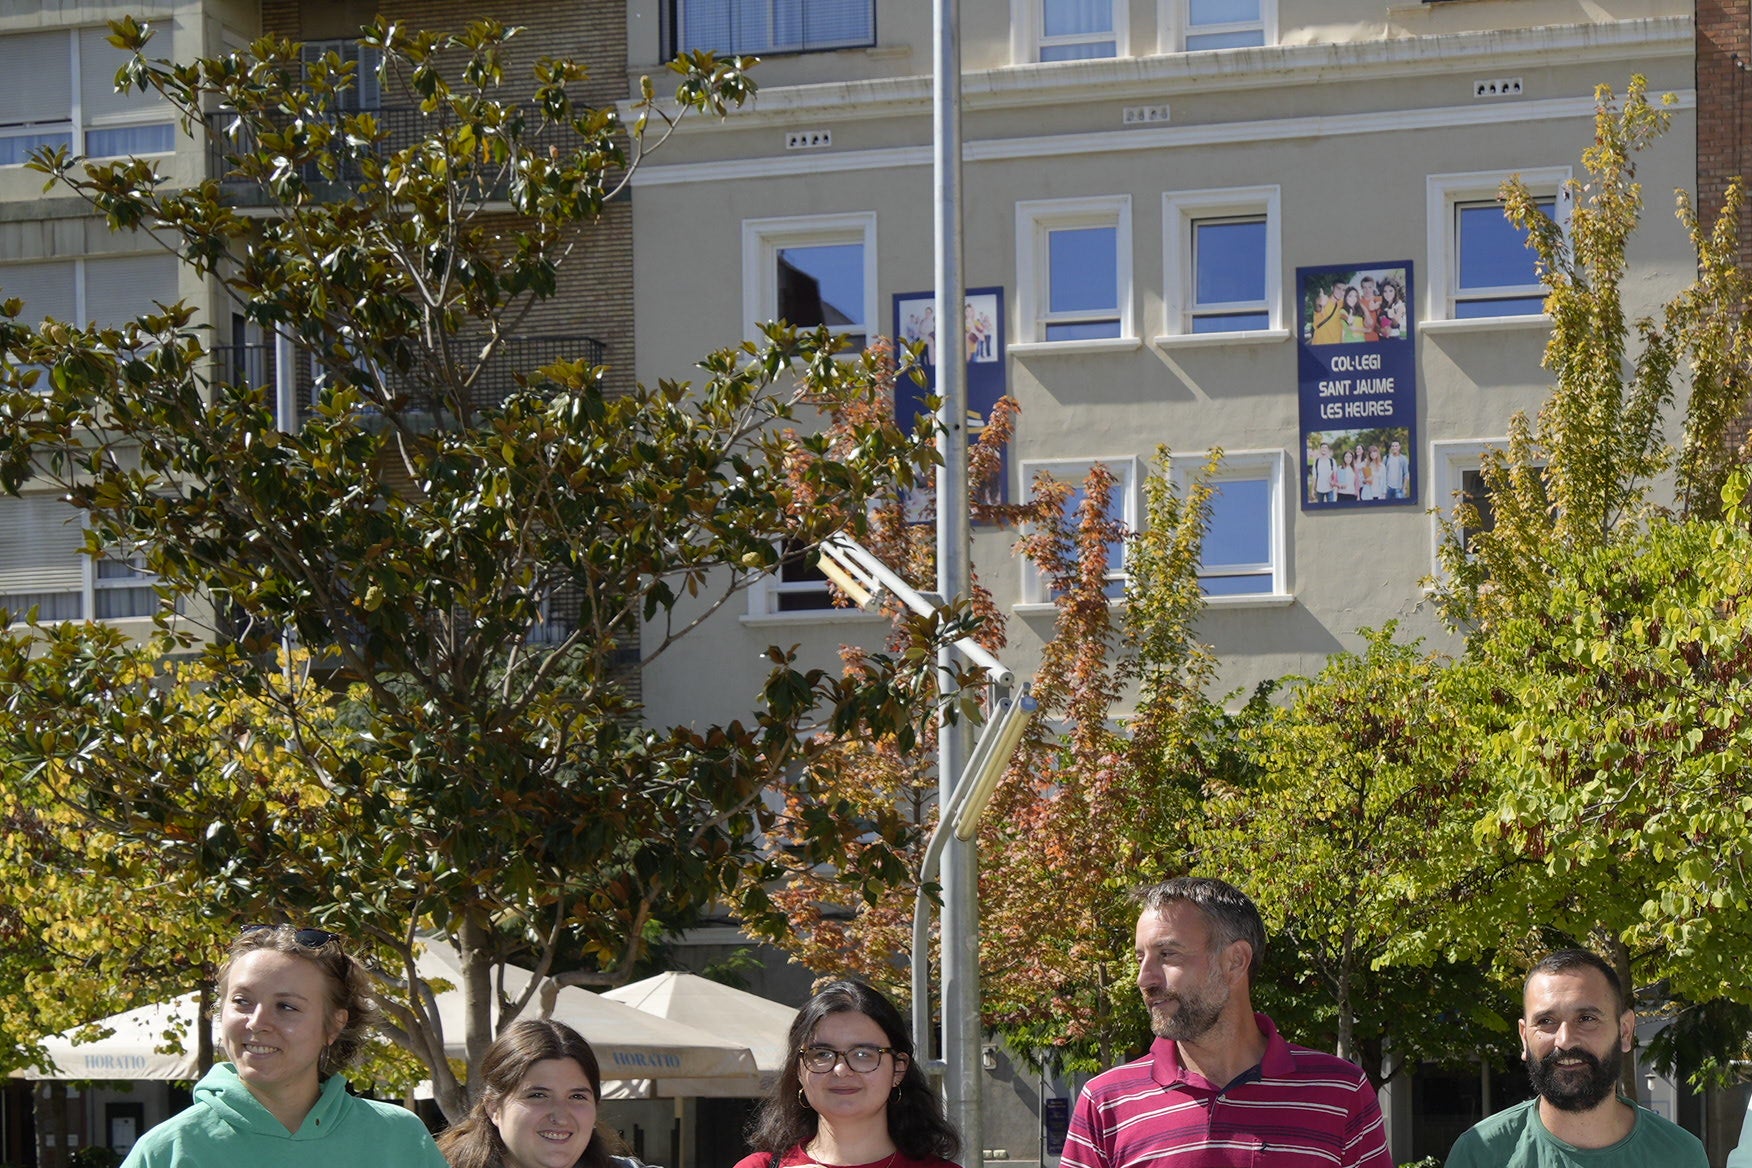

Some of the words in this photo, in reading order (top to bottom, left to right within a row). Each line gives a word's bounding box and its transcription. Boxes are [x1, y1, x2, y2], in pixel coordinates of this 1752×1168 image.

[1331, 354, 1381, 372] COL·LEGI
[1319, 380, 1352, 397] SANT
[1353, 378, 1394, 395] JAUME
[1320, 403, 1343, 419] LES
[1345, 400, 1393, 418] HEURES
[85, 1055, 146, 1069] HORATIO
